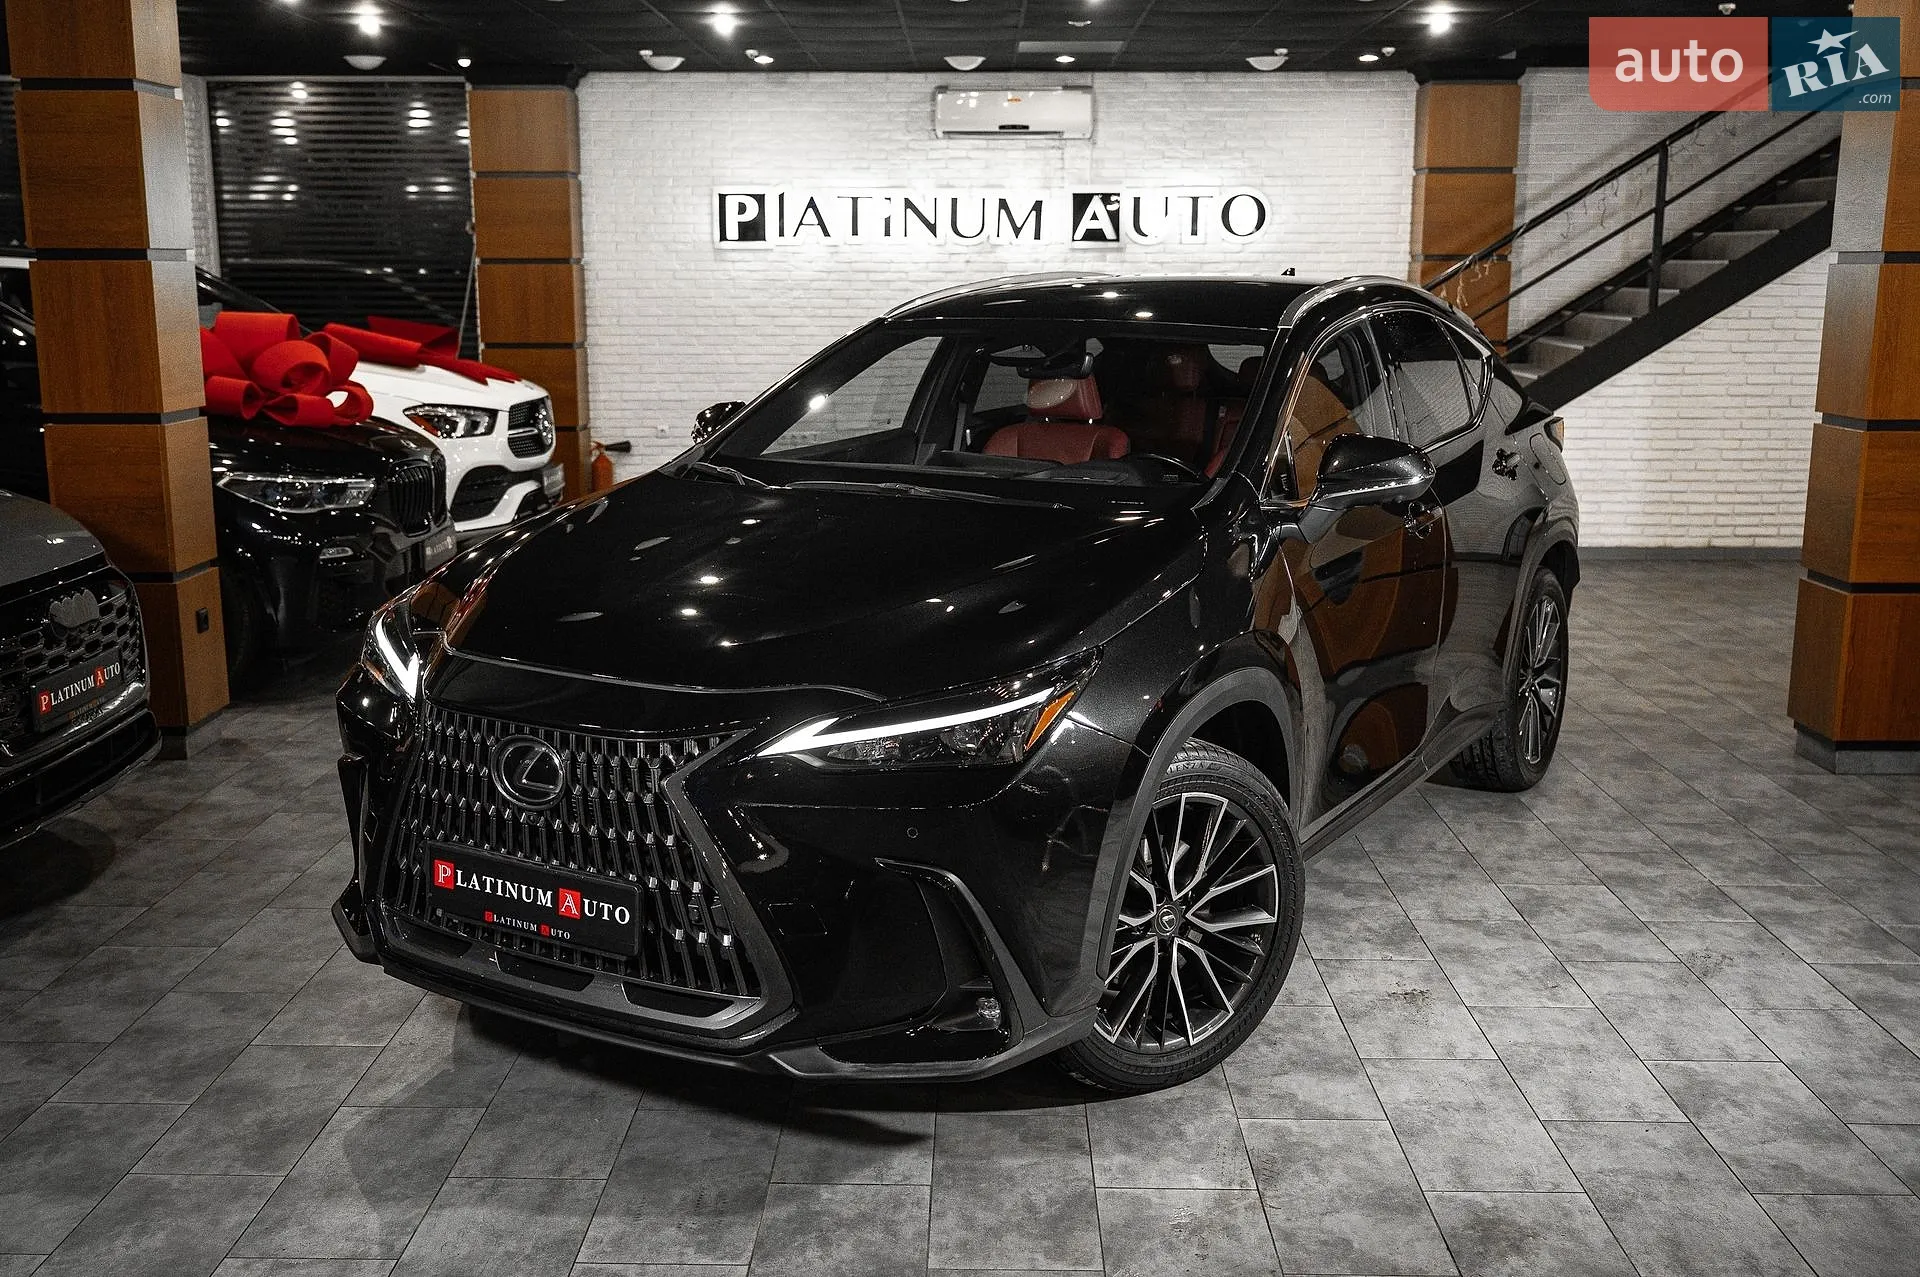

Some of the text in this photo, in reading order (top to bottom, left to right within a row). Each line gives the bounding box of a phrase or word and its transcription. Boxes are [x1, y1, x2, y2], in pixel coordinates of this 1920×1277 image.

[1072, 193, 1266, 242] AUTO
[40, 675, 95, 712] PLATINUM
[96, 662, 120, 686] AUTO
[434, 859, 631, 925] PLATINUM AUTO
[485, 911, 537, 932] PLATINUM
